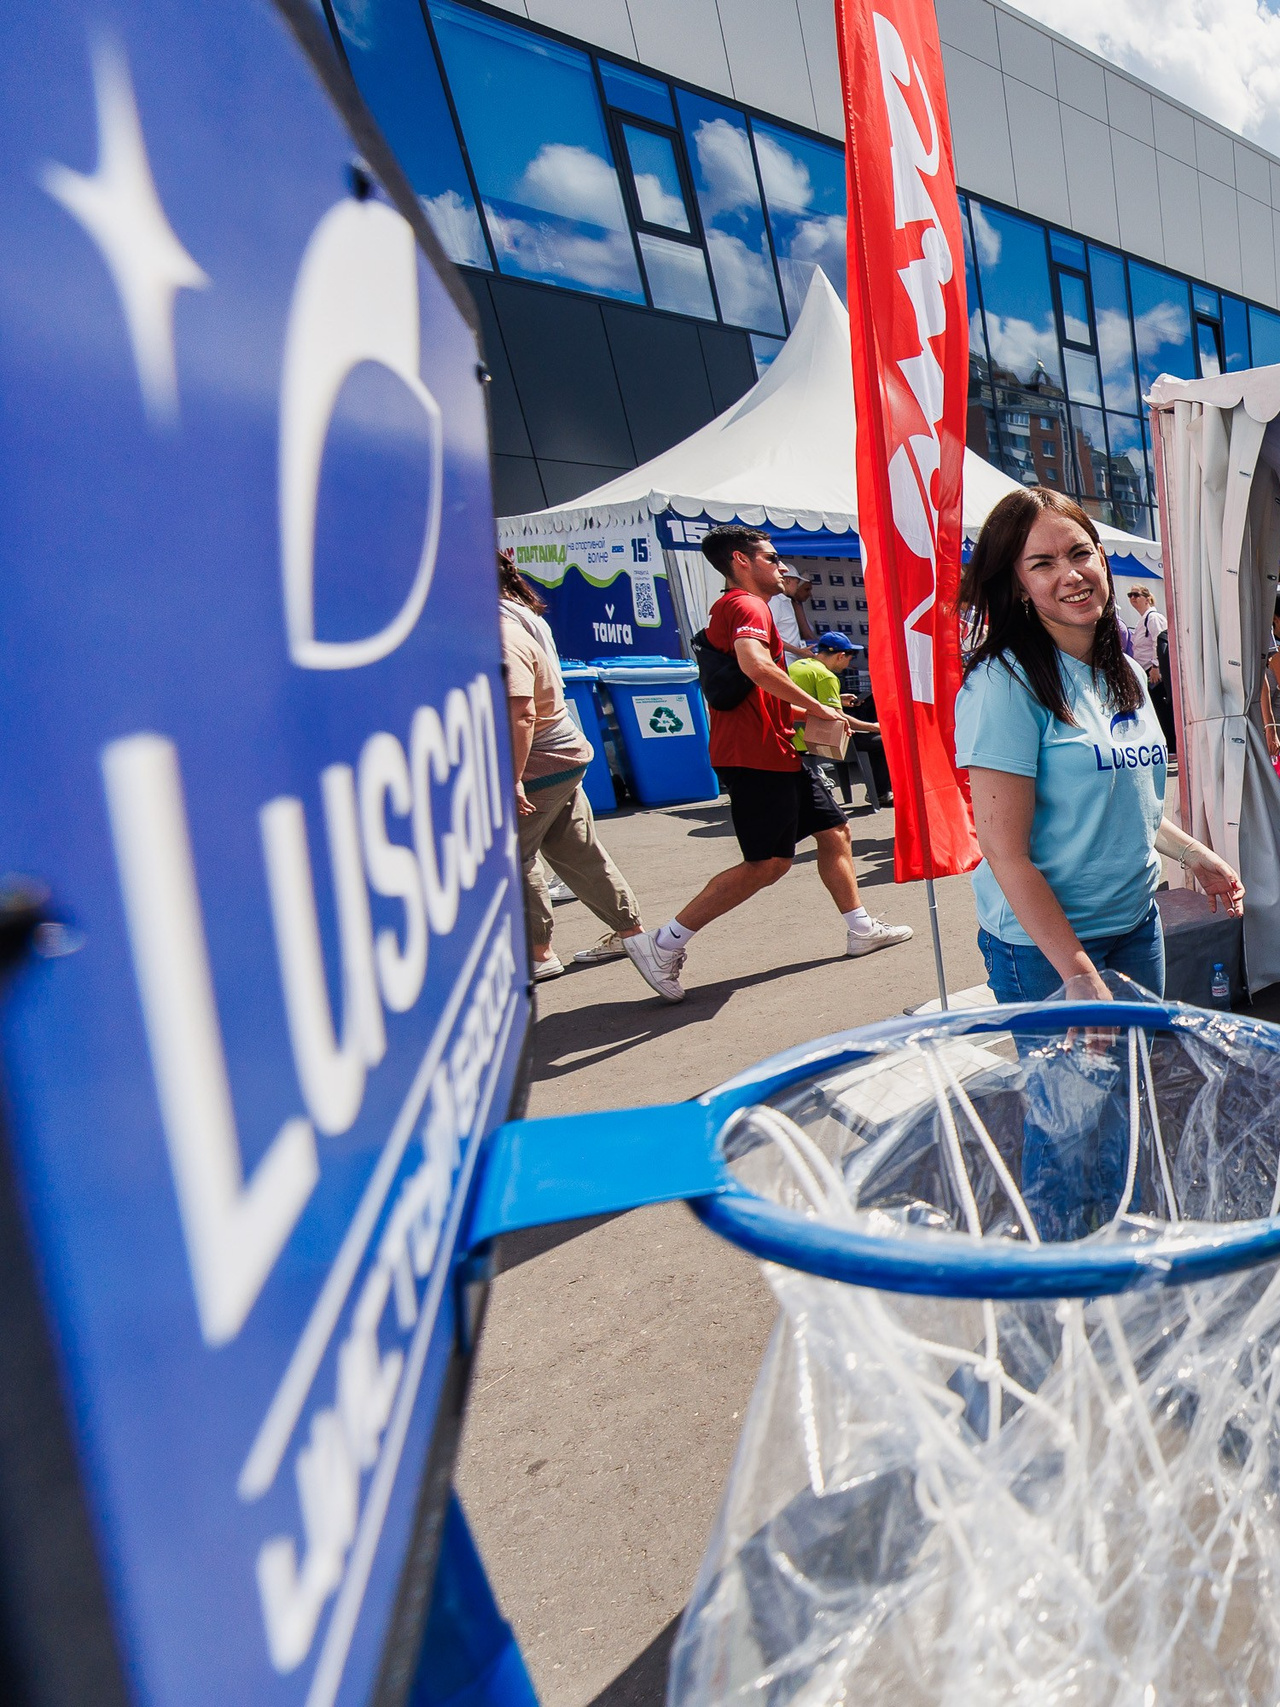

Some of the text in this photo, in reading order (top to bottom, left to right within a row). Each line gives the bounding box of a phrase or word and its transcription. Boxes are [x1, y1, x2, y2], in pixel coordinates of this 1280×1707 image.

[666, 520, 710, 544] 15
[631, 538, 648, 563] 15
[102, 672, 503, 1348] Luscan
